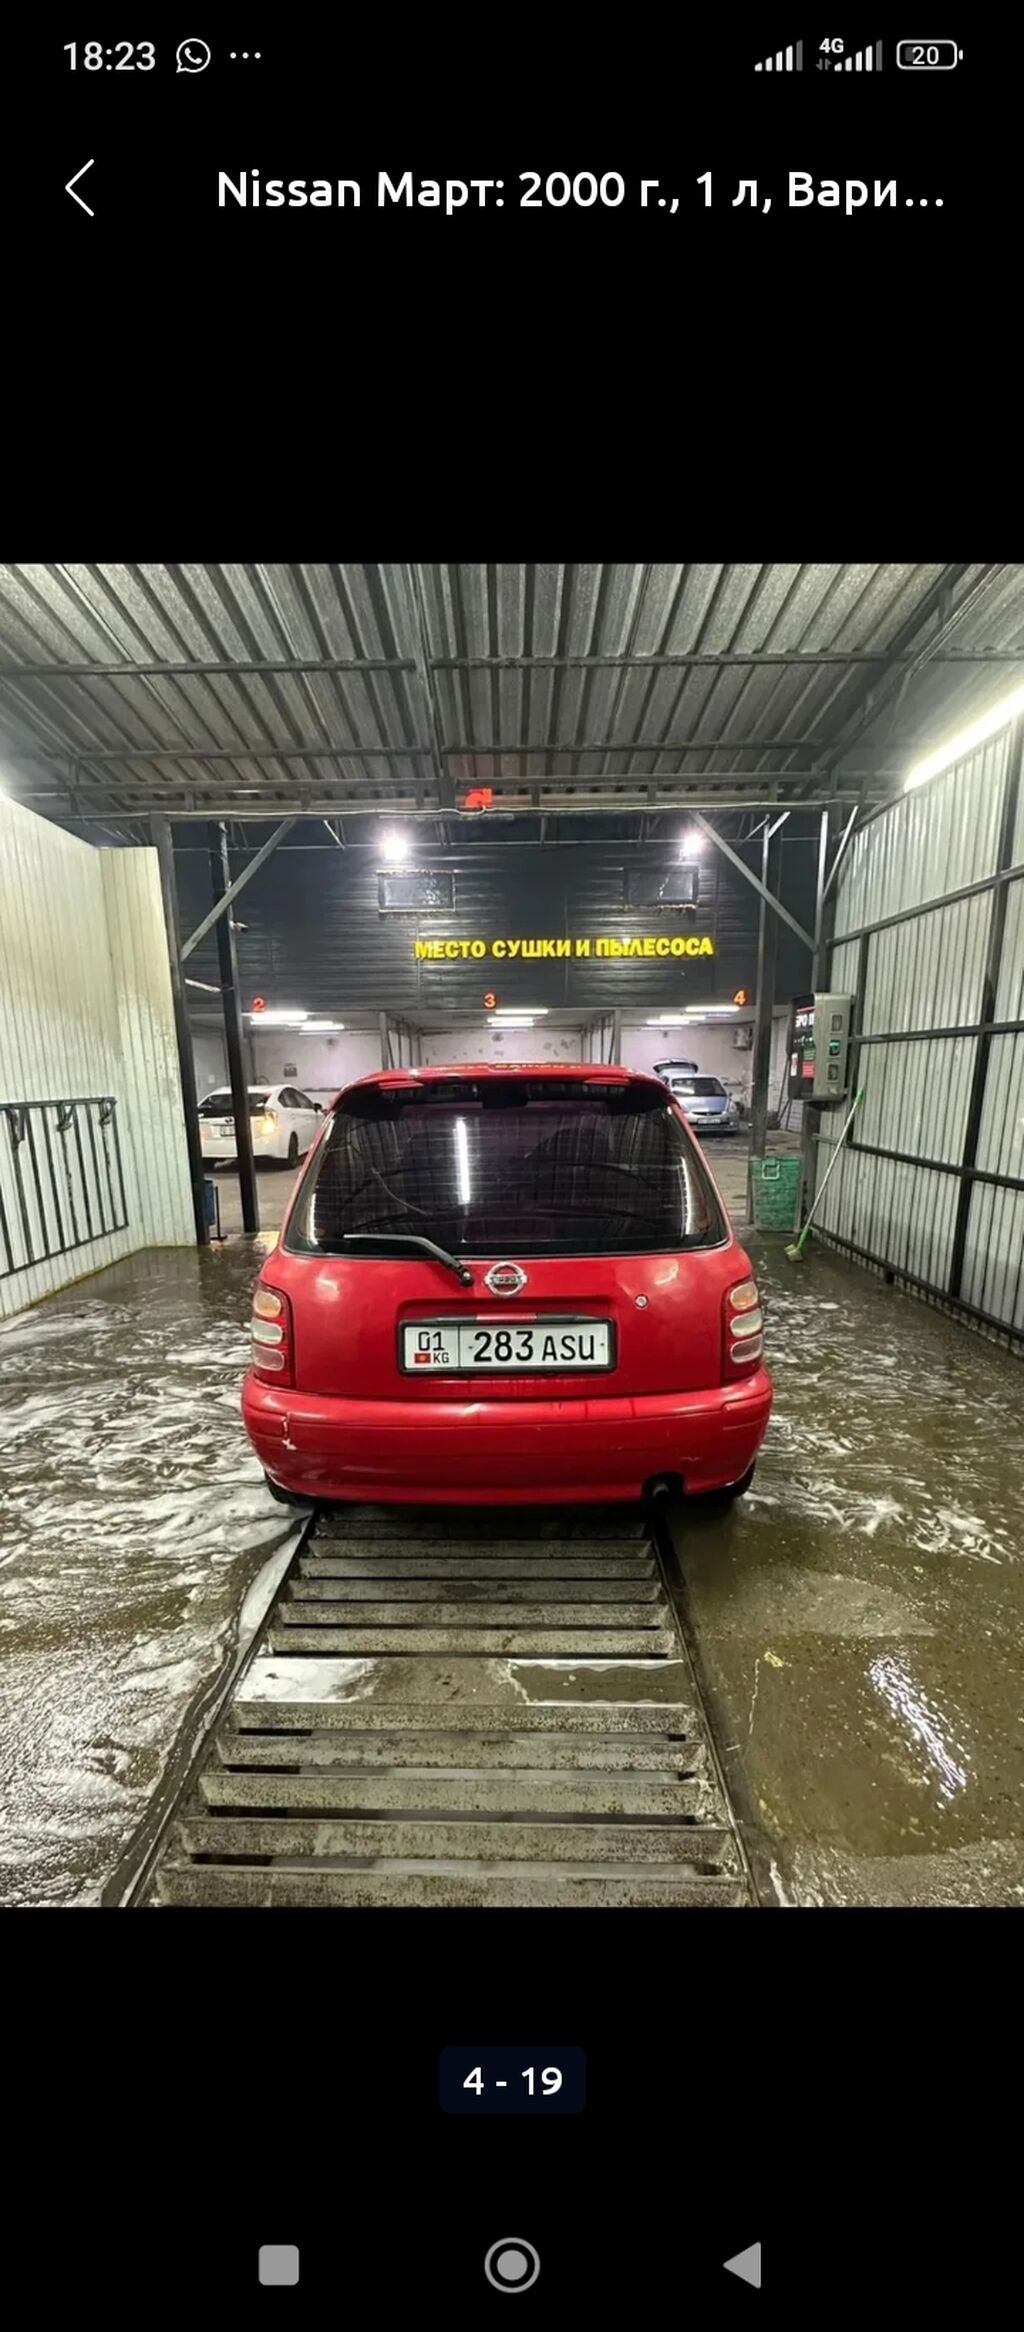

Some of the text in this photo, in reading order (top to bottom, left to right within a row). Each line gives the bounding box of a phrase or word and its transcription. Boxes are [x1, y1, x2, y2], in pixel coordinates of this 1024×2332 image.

[415, 936, 714, 959] МЕСТО СУШКИ И ПЫЛЕСОСА
[254, 997, 266, 1012] 2
[485, 994, 496, 1008] 3
[734, 991, 746, 1005] 4
[418, 1331, 445, 1351] 01
[473, 1330, 594, 1362] 283 ASU
[433, 1352, 449, 1364] KG
